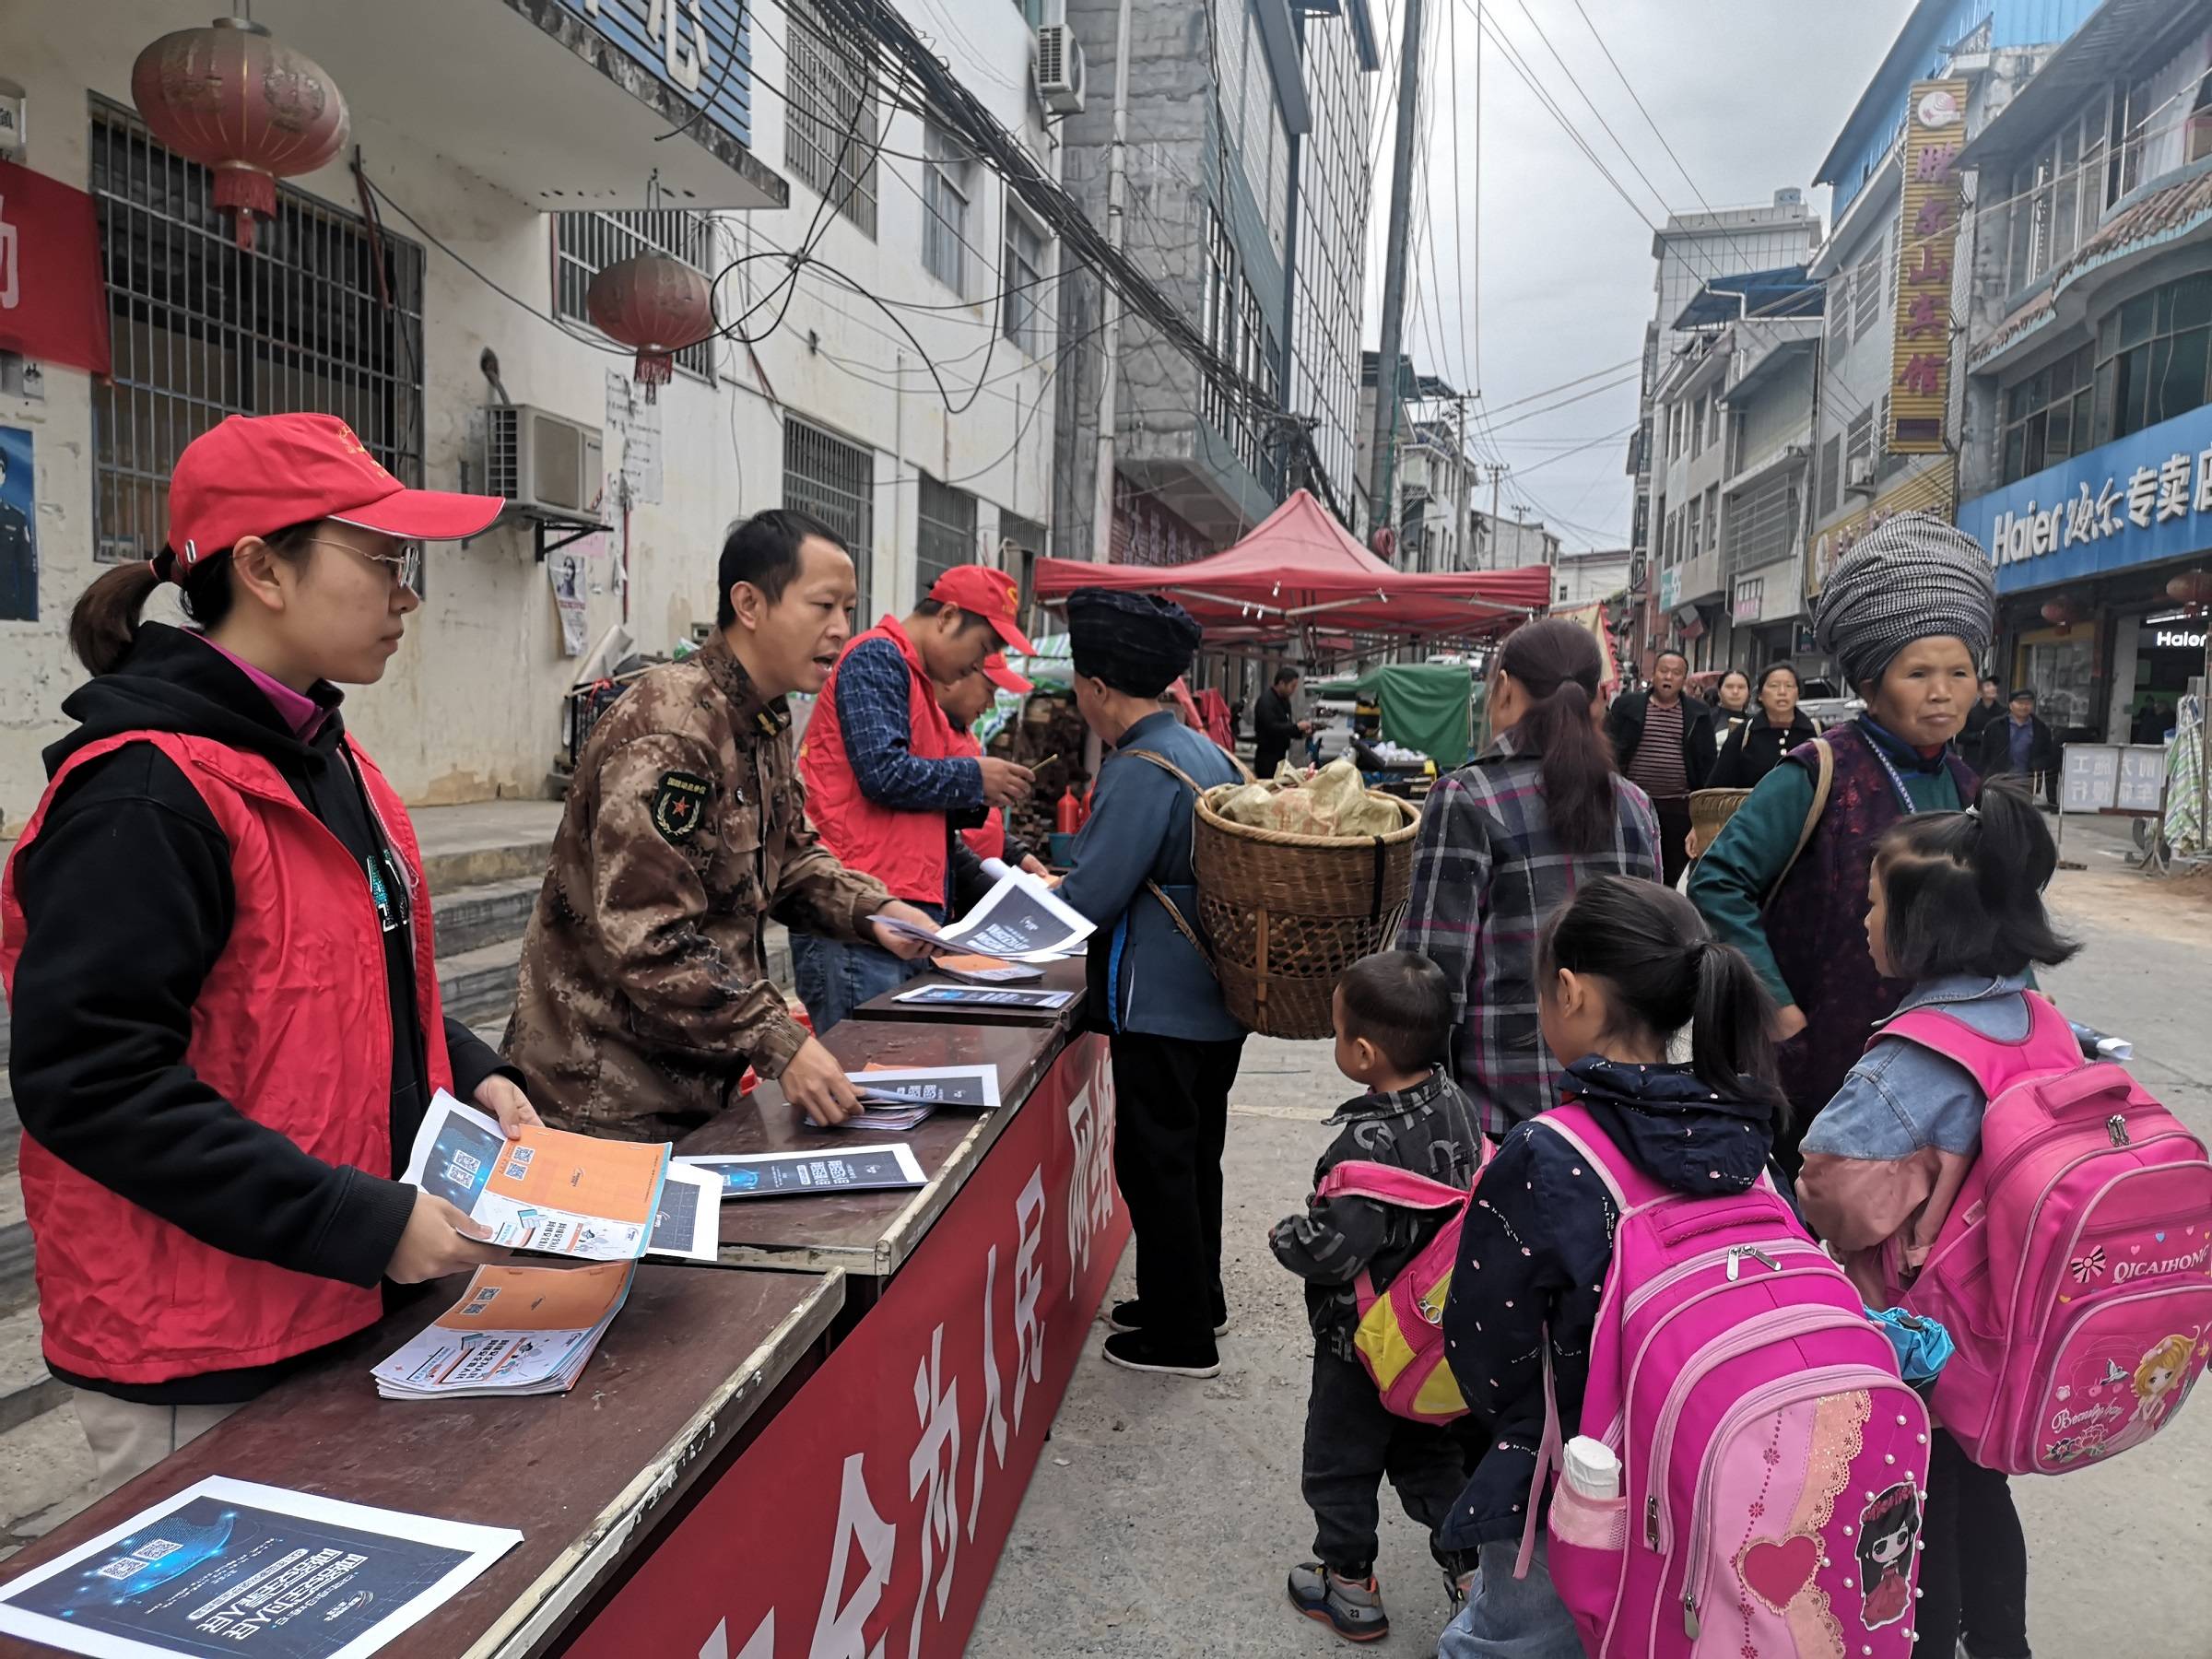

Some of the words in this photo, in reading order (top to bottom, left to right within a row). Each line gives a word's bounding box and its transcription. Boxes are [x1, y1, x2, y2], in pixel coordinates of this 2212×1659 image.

[1992, 500, 2064, 568] Haier
[2157, 630, 2207, 647] Haier
[699, 1163, 1044, 1659] 全为人民
